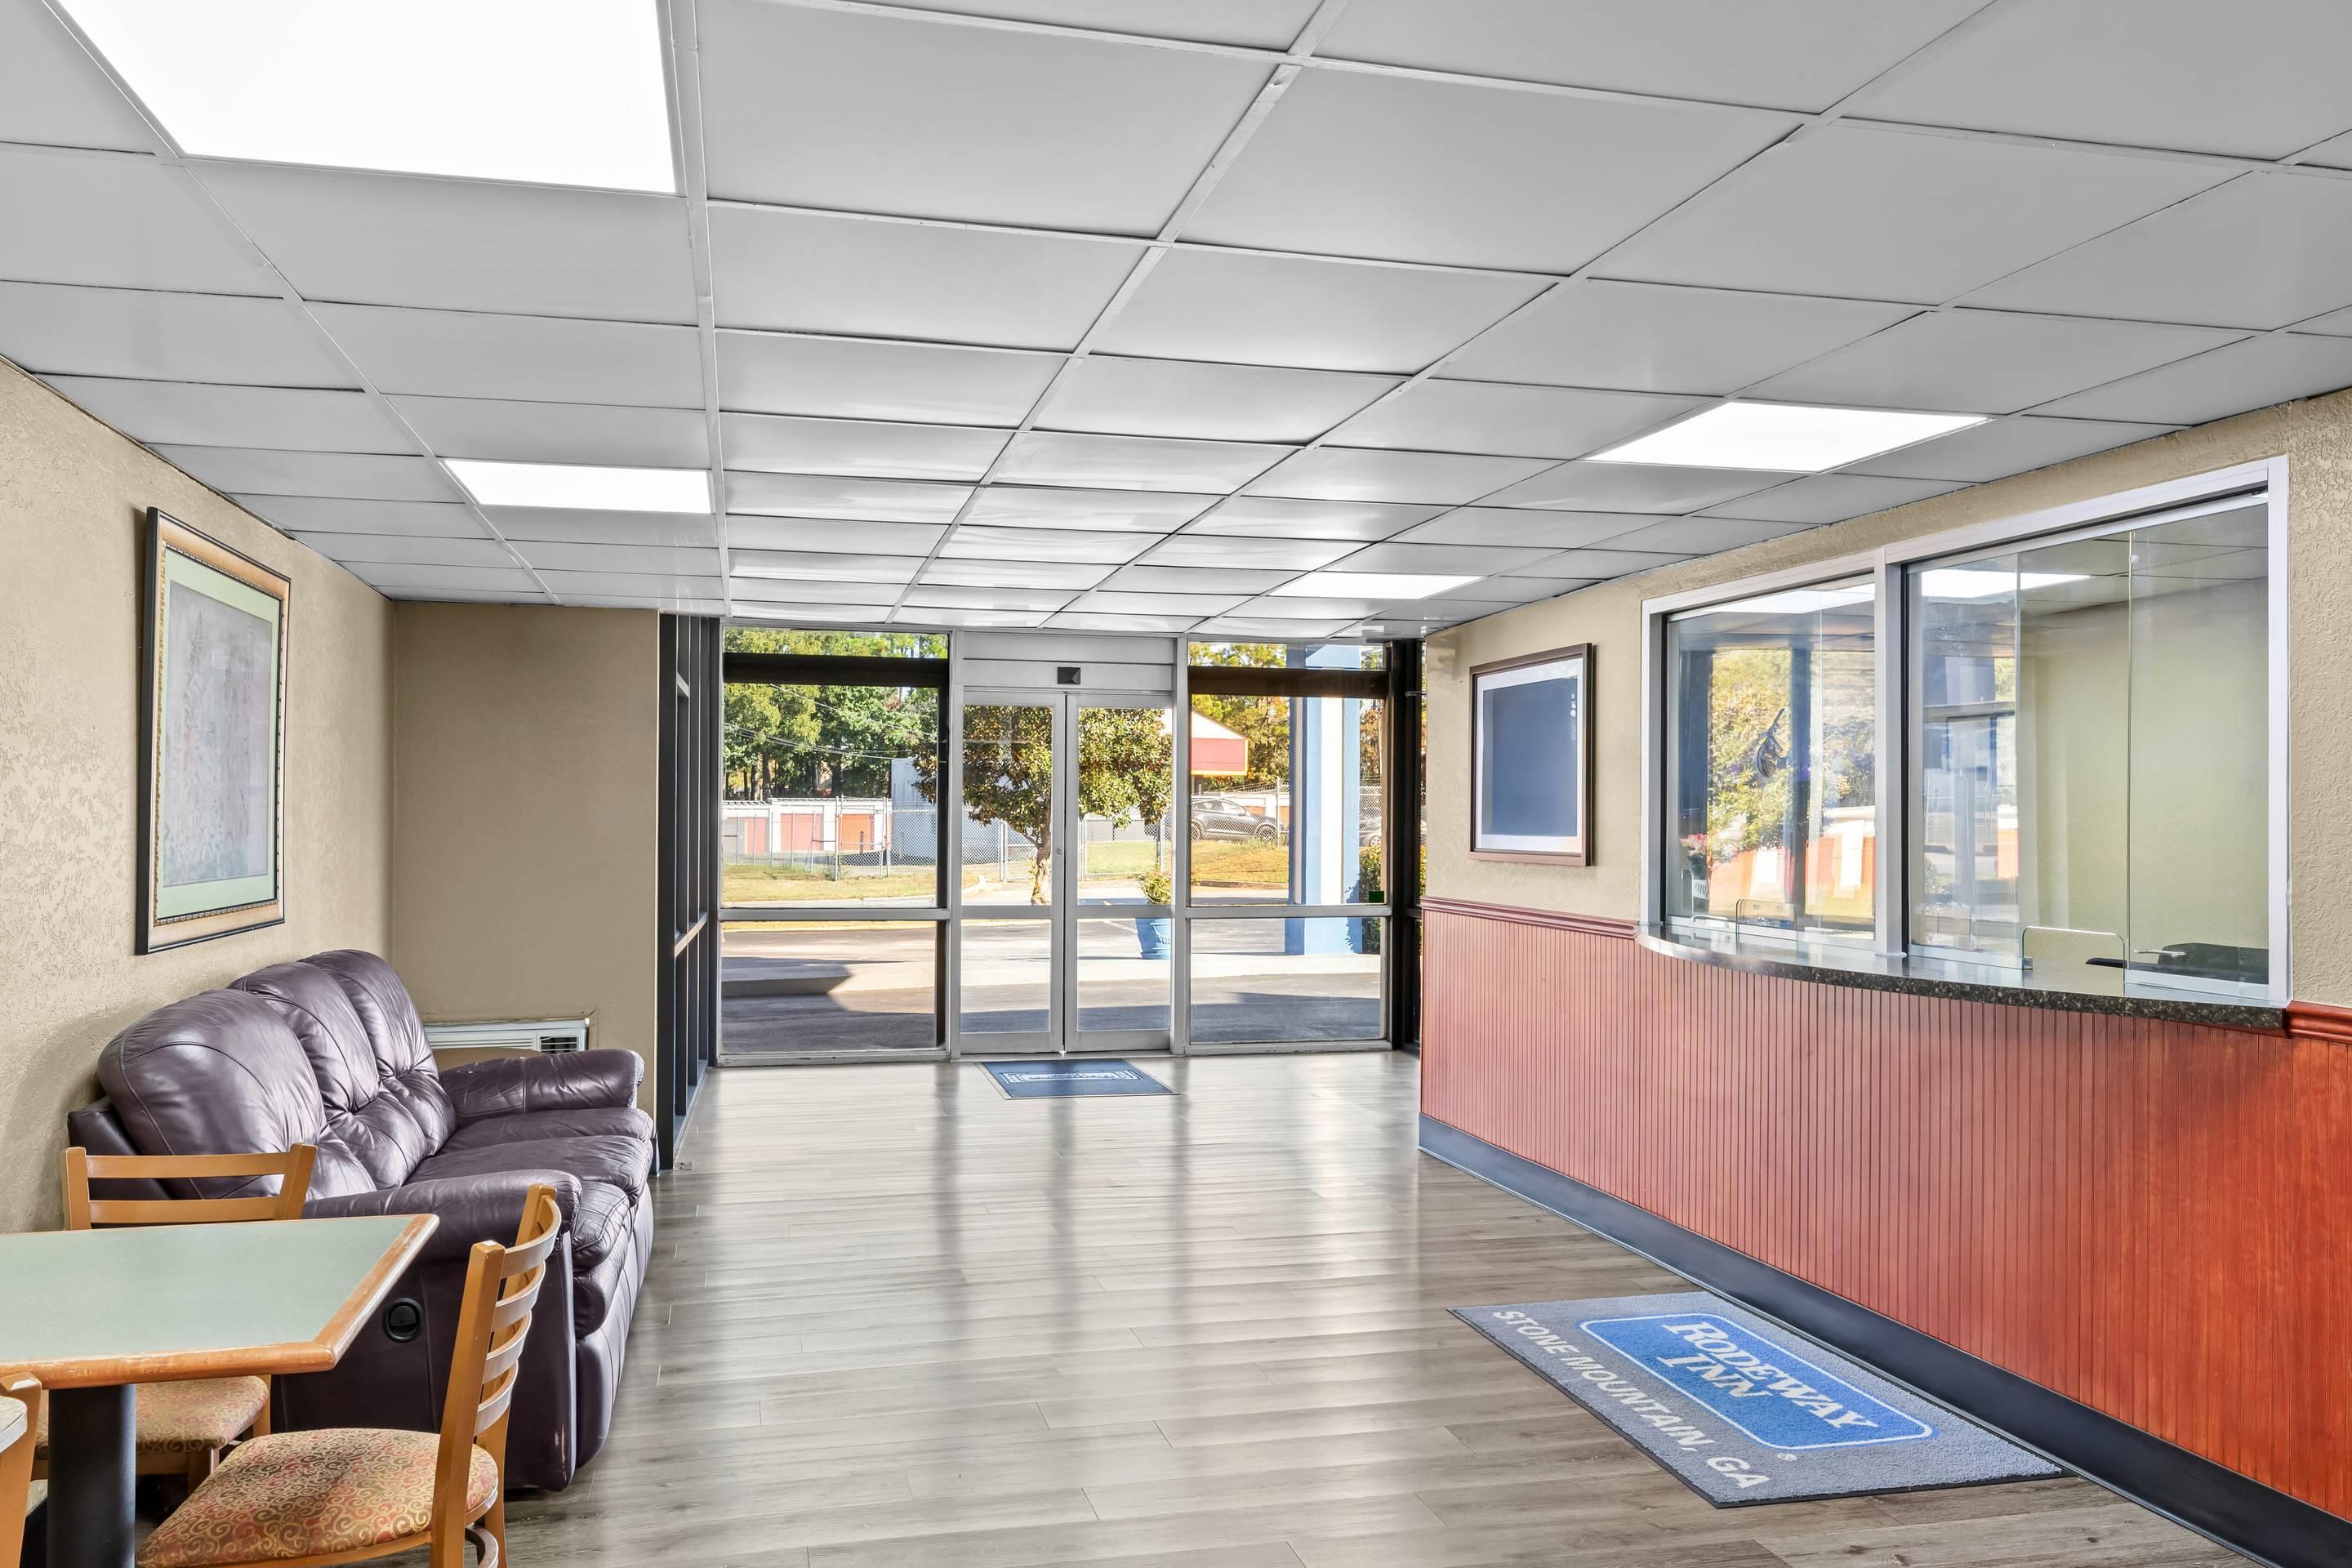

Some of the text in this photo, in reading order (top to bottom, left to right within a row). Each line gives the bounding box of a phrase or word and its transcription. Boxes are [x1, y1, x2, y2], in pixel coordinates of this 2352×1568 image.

[1493, 1311, 1770, 1488] STONE MOUNTAIN, GA
[1657, 1353, 1773, 1398] INN
[1663, 1322, 1879, 1428] RODEWAY
